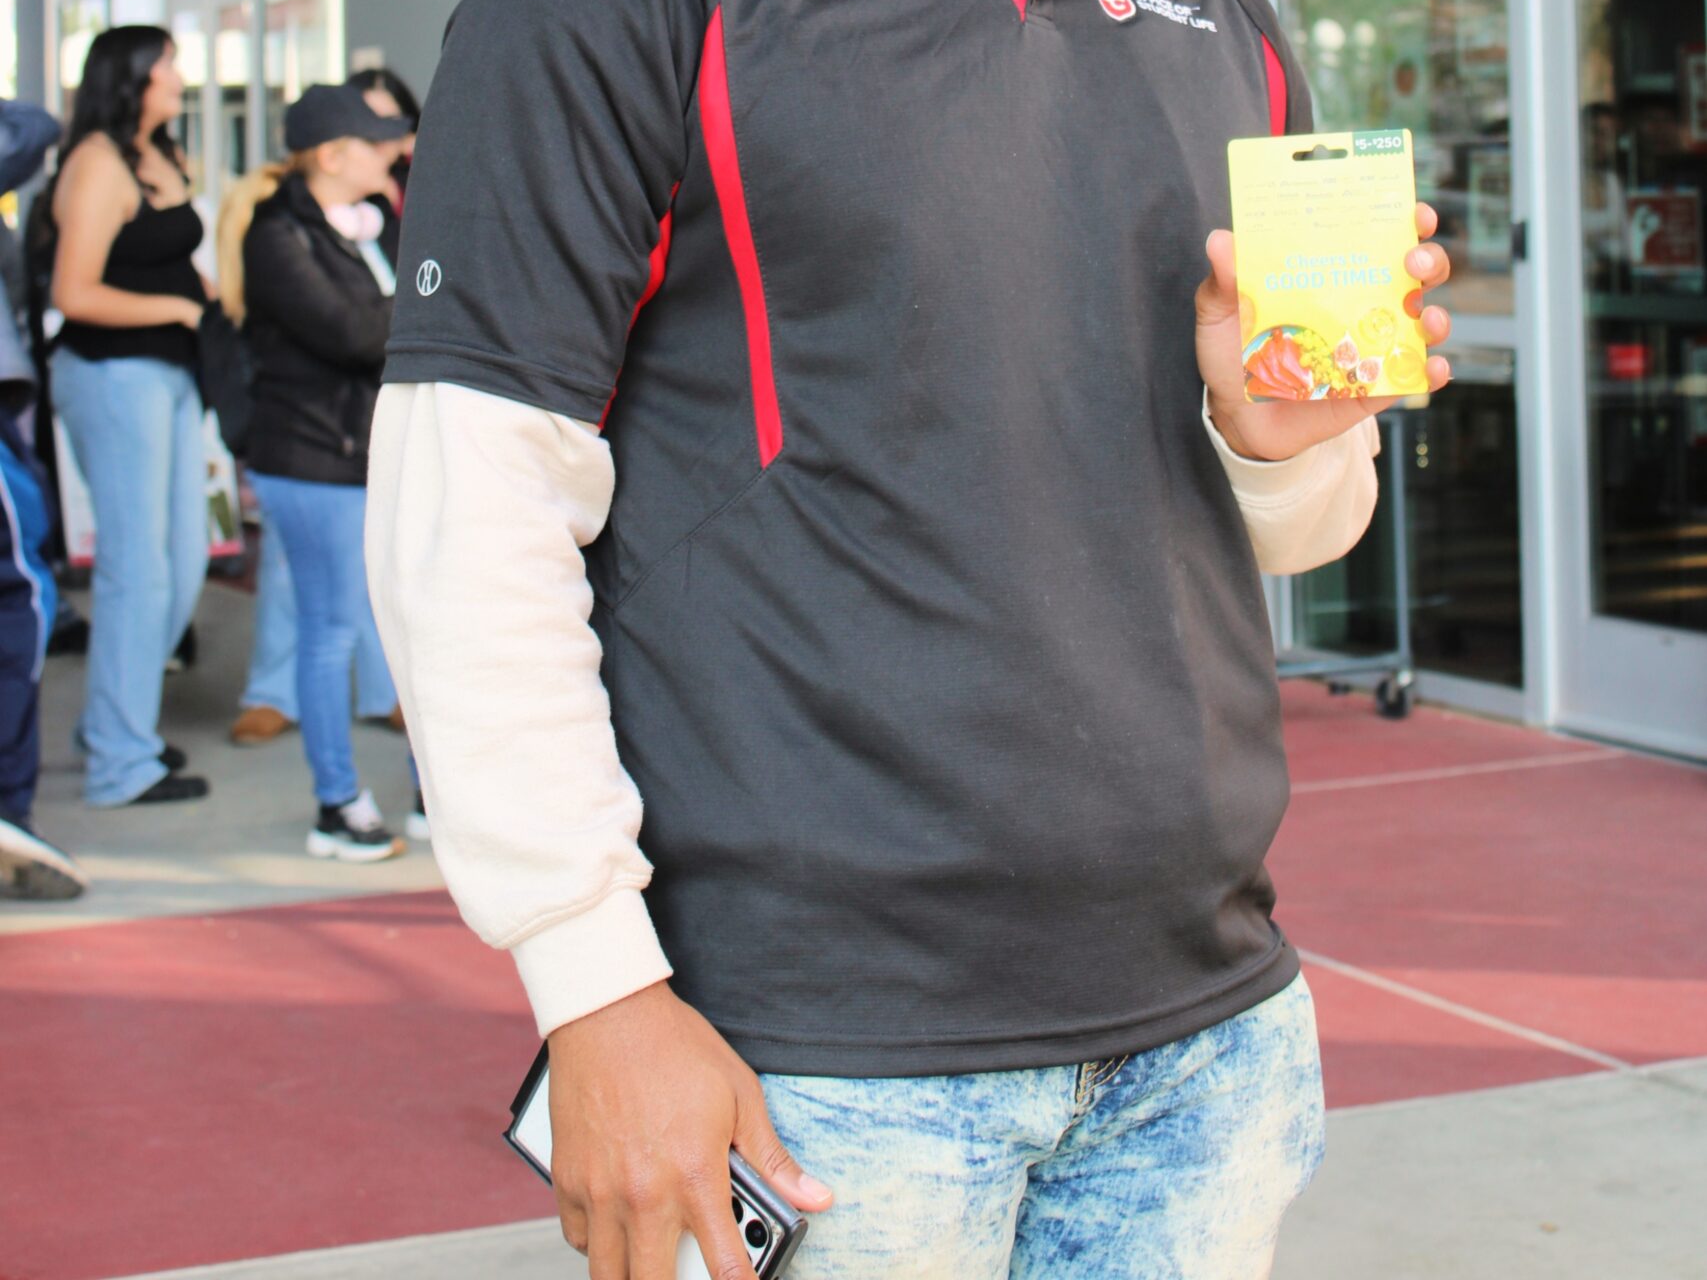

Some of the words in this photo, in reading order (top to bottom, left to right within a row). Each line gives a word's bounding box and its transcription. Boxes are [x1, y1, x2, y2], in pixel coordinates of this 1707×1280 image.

[1285, 254, 1346, 269] Cheers
[1350, 251, 1369, 265] to
[1265, 272, 1324, 291] GOOD
[1330, 267, 1392, 288] TIMES
